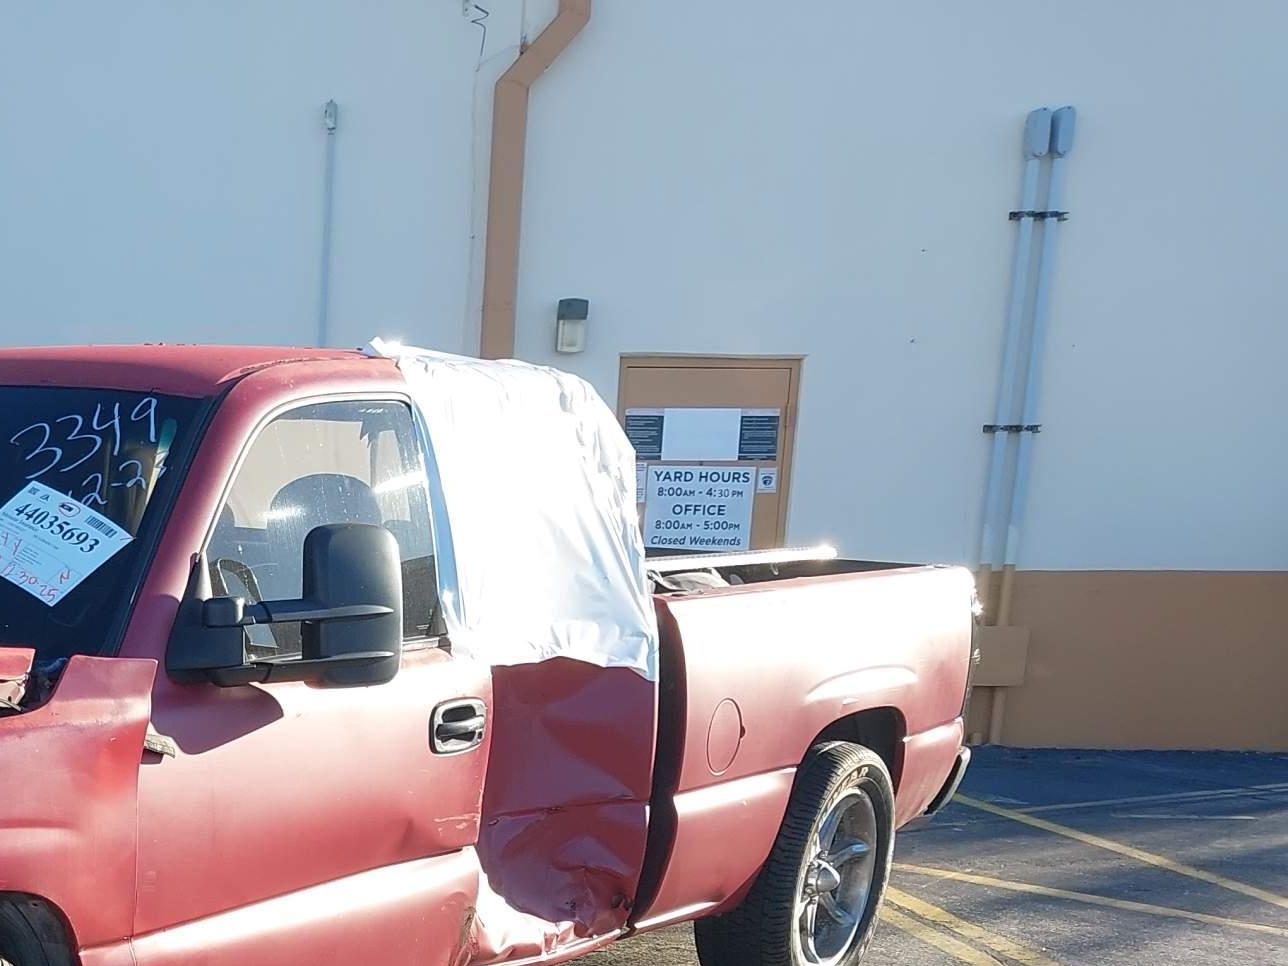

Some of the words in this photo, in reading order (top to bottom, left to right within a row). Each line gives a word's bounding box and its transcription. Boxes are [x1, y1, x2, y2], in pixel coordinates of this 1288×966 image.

[10, 397, 158, 480] 3349
[653, 470, 694, 483] YARD
[698, 471, 751, 484] HOURS
[657, 487, 696, 498] 8:00AM
[705, 487, 730, 498] 4:30
[731, 490, 744, 498] PM
[672, 503, 727, 517] OFFICE
[14, 502, 101, 554] 44035693
[655, 520, 693, 531] 8:00AM
[703, 520, 741, 531] 5:00PM
[650, 535, 687, 546] Closed
[688, 536, 742, 547] Weekends
